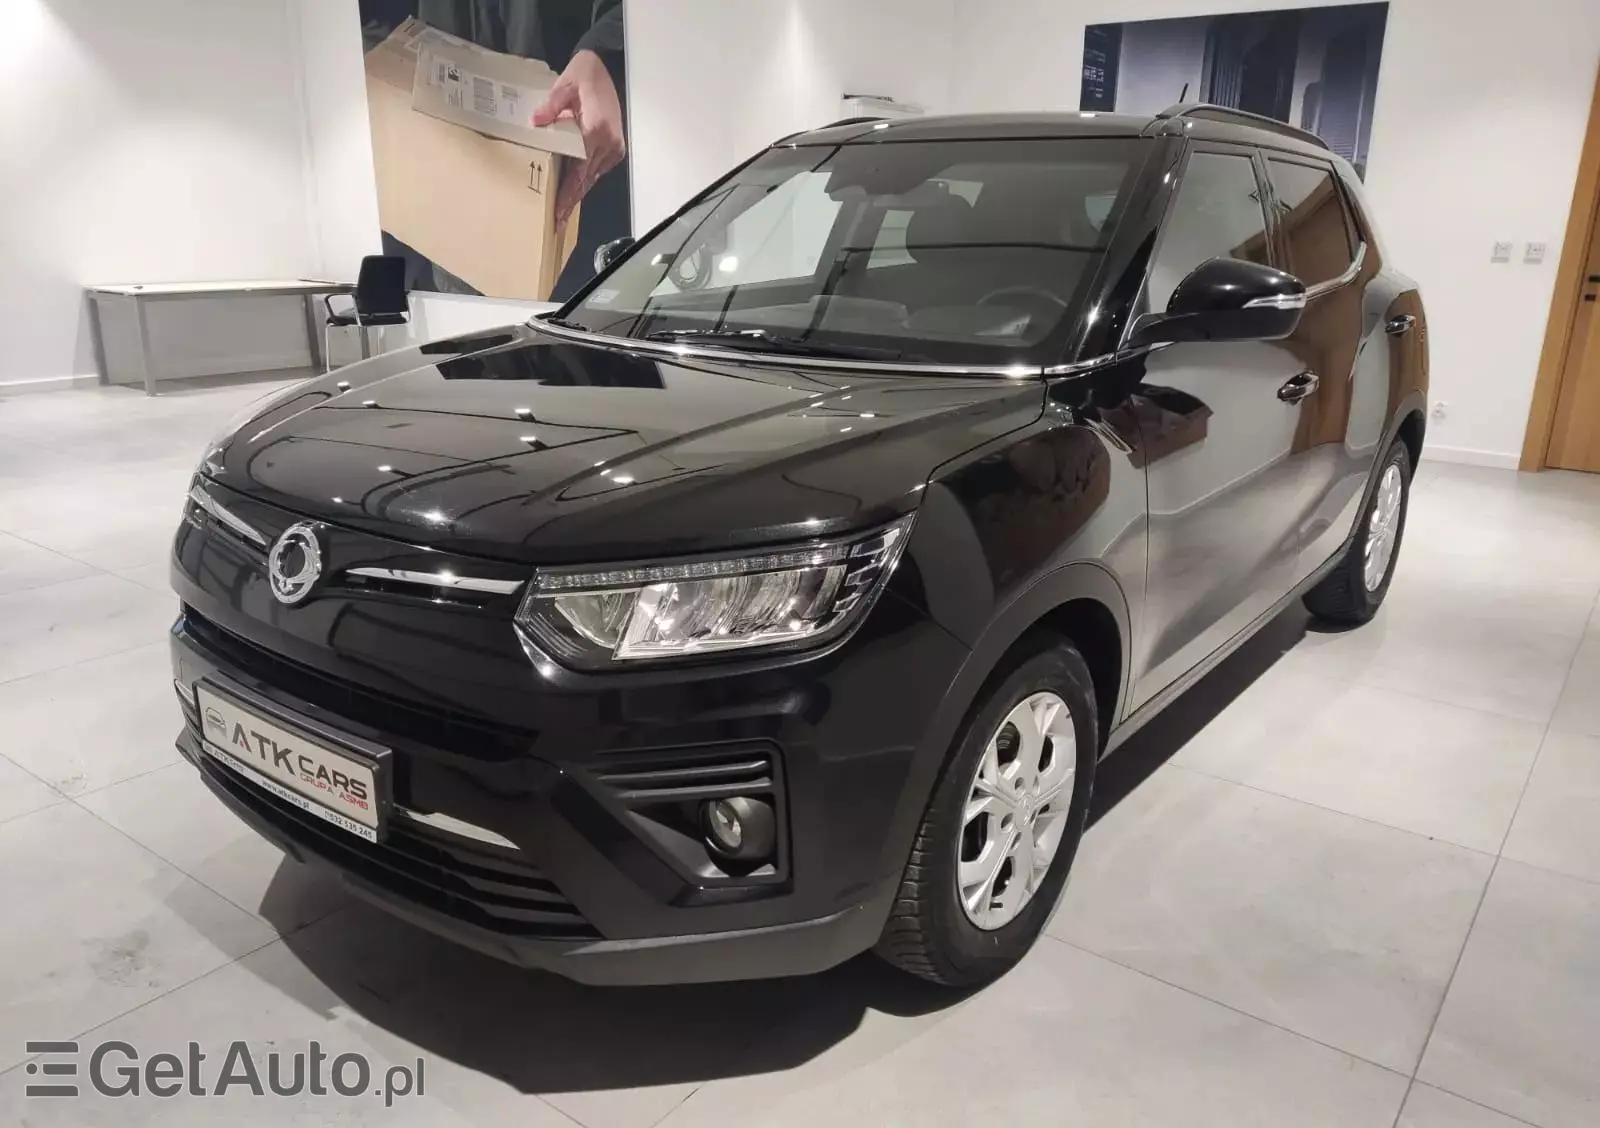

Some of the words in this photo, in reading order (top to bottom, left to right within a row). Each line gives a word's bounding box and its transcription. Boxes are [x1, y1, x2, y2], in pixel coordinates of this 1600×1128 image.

[232, 722, 296, 776] ATK
[298, 755, 368, 800] CARS
[300, 773, 334, 795] GRUPA
